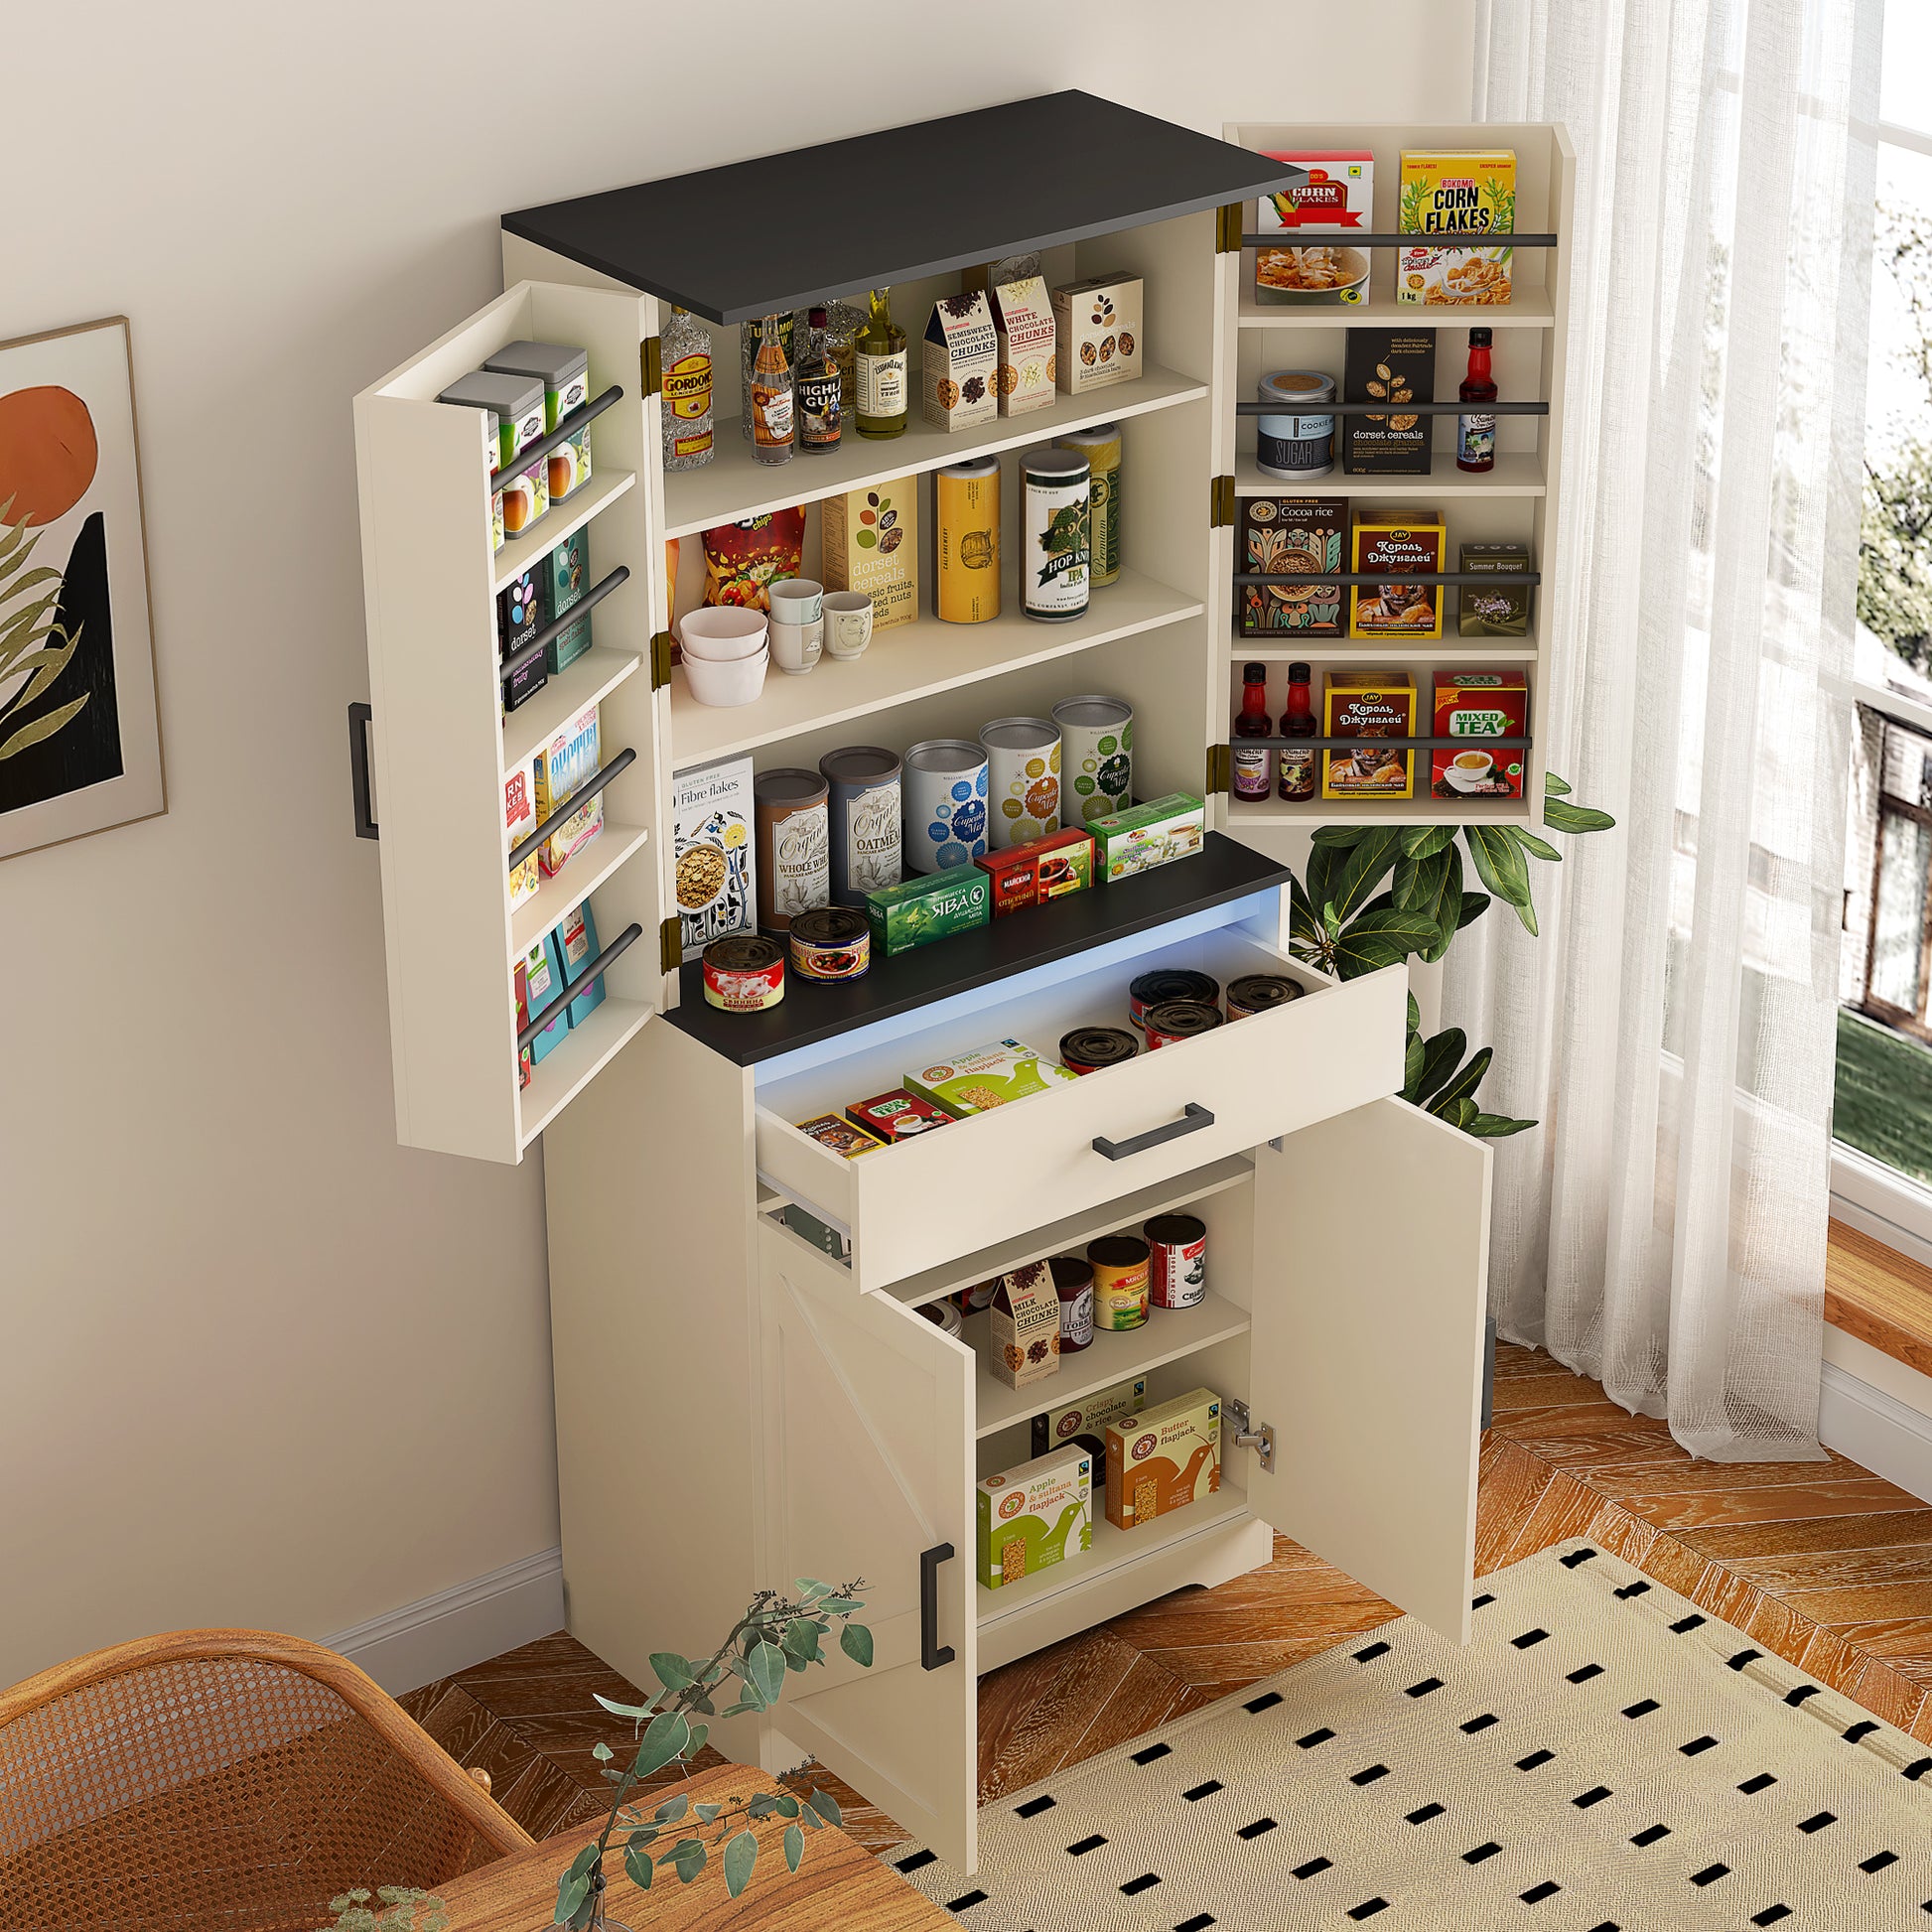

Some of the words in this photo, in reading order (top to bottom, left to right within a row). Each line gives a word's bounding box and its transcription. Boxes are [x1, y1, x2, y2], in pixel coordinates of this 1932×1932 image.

[1292, 188, 1336, 197] CORN
[1434, 186, 1478, 209] CORN
[1426, 207, 1489, 232] FLAKES
[1006, 312, 1037, 326] WHITE
[1009, 317, 1053, 334] CHOCOLATE
[947, 324, 993, 341] SEMISWEET
[949, 332, 995, 348] CHOCOLATE
[1010, 325, 1054, 344] CHUNKS
[951, 340, 996, 357] CHUNKS
[664, 371, 712, 392] GORDON'S
[1302, 420, 1328, 430] COOKIE
[1276, 440, 1312, 465] SUGAR
[1282, 507, 1312, 517] Cocoa
[1315, 507, 1333, 516] rice
[752, 513, 773, 531] chips
[1092, 519, 1106, 575] Premium
[1376, 541, 1423, 553] Король
[1048, 554, 1072, 573] HOP
[1367, 551, 1431, 563] Джунглей
[853, 554, 899, 577] dorset
[1501, 562, 1528, 572] Bouquet
[853, 568, 905, 592] cereals
[1068, 568, 1083, 582] IPA
[557, 588, 581, 615] dorset
[891, 591, 911, 604] nuts
[511, 623, 536, 651] dorset
[1348, 704, 1393, 715] Король
[1339, 714, 1402, 726] Джунглей
[1456, 722, 1497, 735] TEA
[1099, 765, 1129, 780] Cupcake
[682, 777, 704, 788] GLUTEN
[1114, 777, 1127, 786] Mix
[681, 787, 708, 805] Fibre
[710, 779, 739, 797] flakes
[1028, 787, 1057, 804] Cupcake
[1041, 799, 1055, 810] Mix
[954, 811, 985, 827] Cupcake
[967, 823, 983, 834] Mix
[779, 861, 812, 874] WHOLE
[930, 895, 969, 920] ЯВА
[951, 1052, 981, 1065] Apple
[964, 1056, 1007, 1074] flapjack
[969, 1050, 1007, 1065] sultana
[872, 1100, 900, 1112] MIXED
[878, 1103, 906, 1116] TEA
[1014, 1298, 1036, 1311] MILK
[1016, 1300, 1058, 1318] CHOCOLATE
[1017, 1307, 1059, 1327] CHUNKS
[1085, 1397, 1114, 1413] Crispy
[1085, 1400, 1127, 1422] chocolate
[1095, 1415, 1112, 1428] rice
[1161, 1420, 1189, 1436] Butter
[1161, 1426, 1195, 1445] flapjack
[1029, 1477, 1056, 1494] Apple
[1037, 1480, 1072, 1499] sultana
[1029, 1492, 1065, 1513] flapjack
